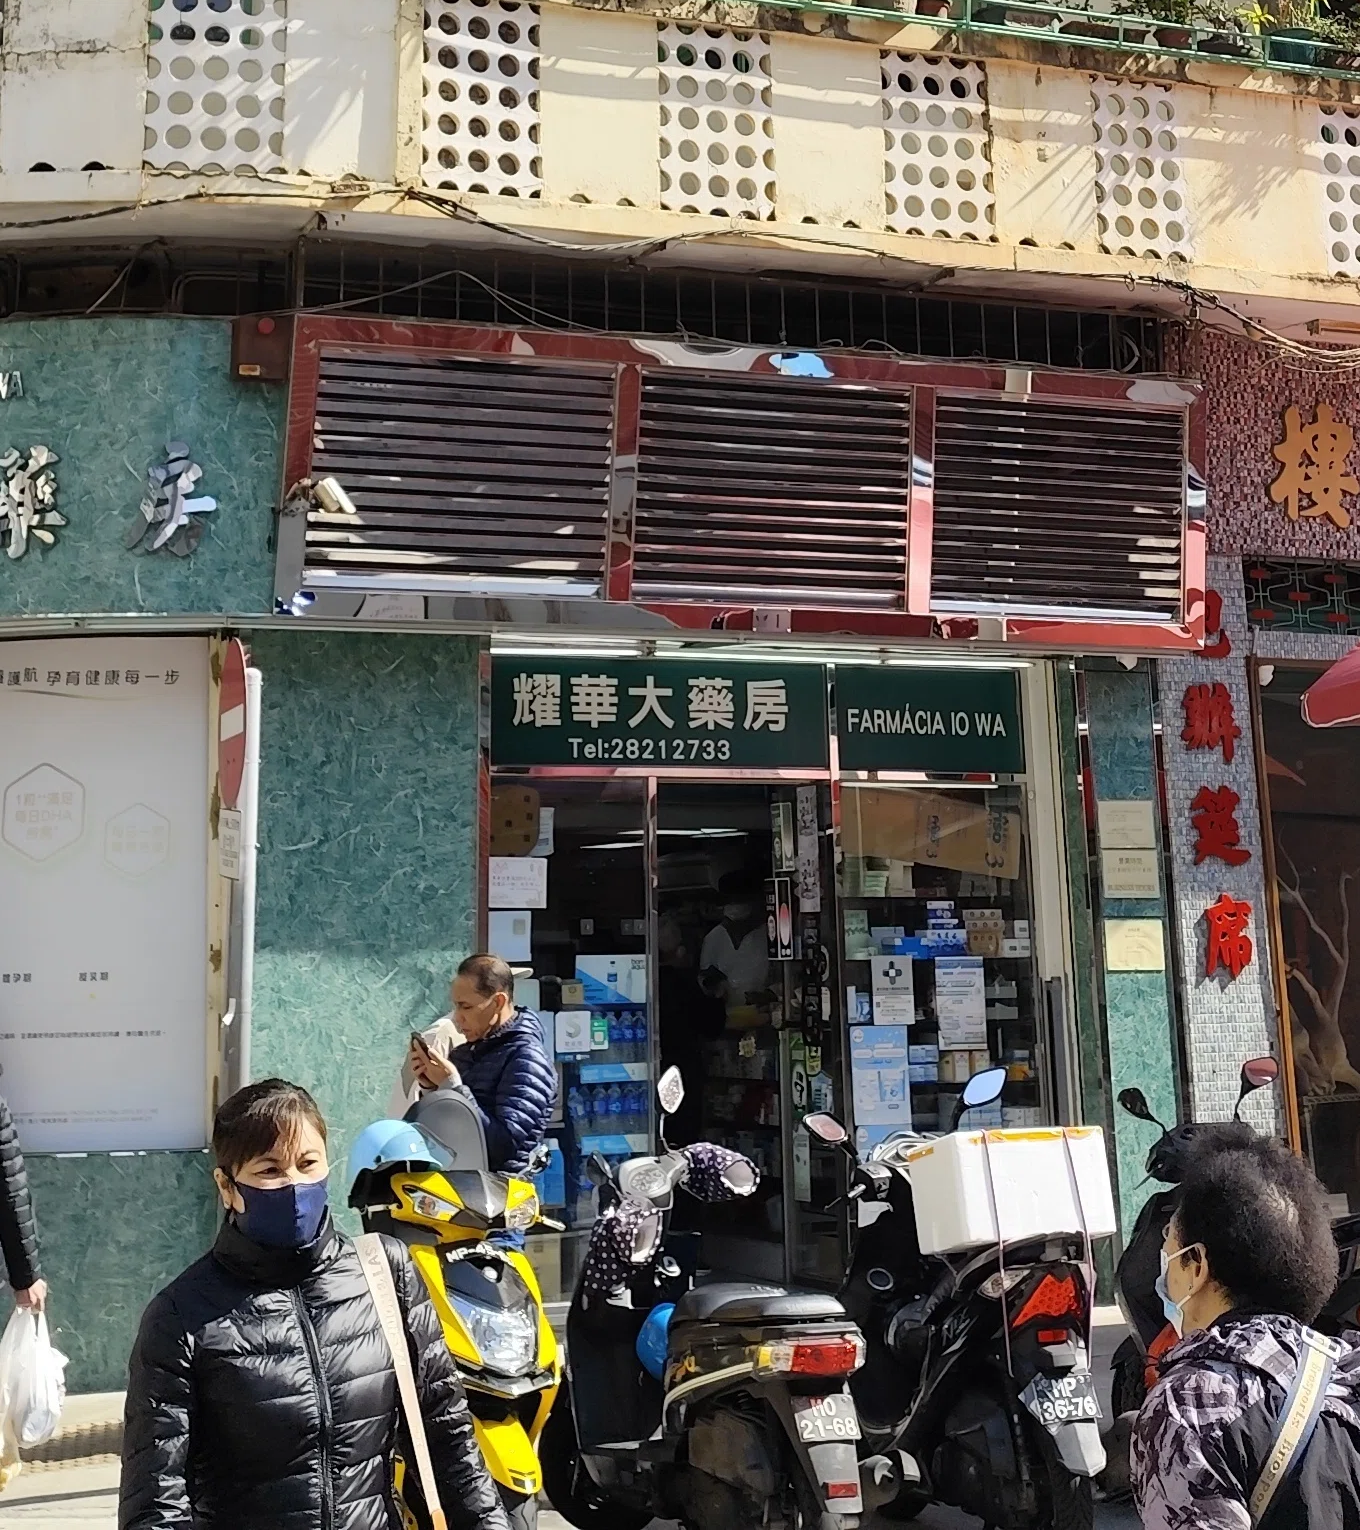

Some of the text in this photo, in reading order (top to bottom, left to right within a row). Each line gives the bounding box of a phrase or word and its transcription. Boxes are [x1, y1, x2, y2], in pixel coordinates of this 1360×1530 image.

[513, 673, 789, 731] 耀華大藥房
[847, 703, 1006, 737] FARMÁCIA IO WA
[568, 736, 731, 760] Tel:28212733
[1051, 1376, 1077, 1398] MP
[800, 1416, 858, 1440] 21-68
